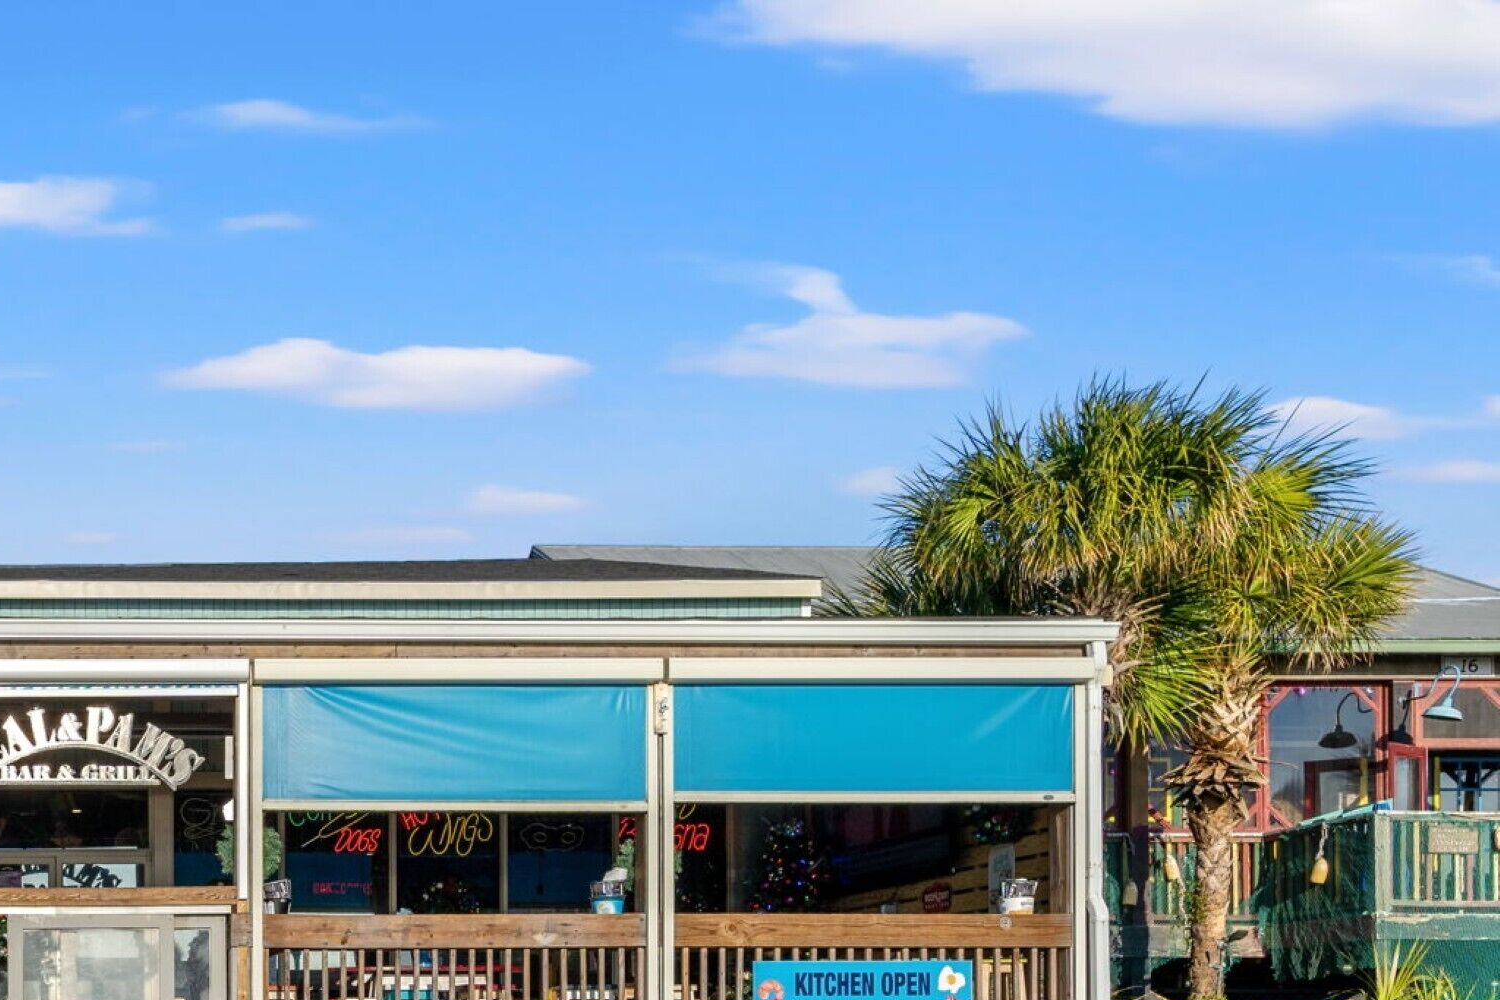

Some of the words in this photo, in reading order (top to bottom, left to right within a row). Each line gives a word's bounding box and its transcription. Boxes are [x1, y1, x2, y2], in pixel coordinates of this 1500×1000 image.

[1460, 658, 1479, 673] 16
[1, 764, 49, 780] BAR
[56, 764, 76, 780] &
[81, 764, 157, 781] GRILL
[334, 828, 381, 852] DOGS
[794, 972, 875, 996] KITCHEN
[881, 972, 931, 996] OPEN
